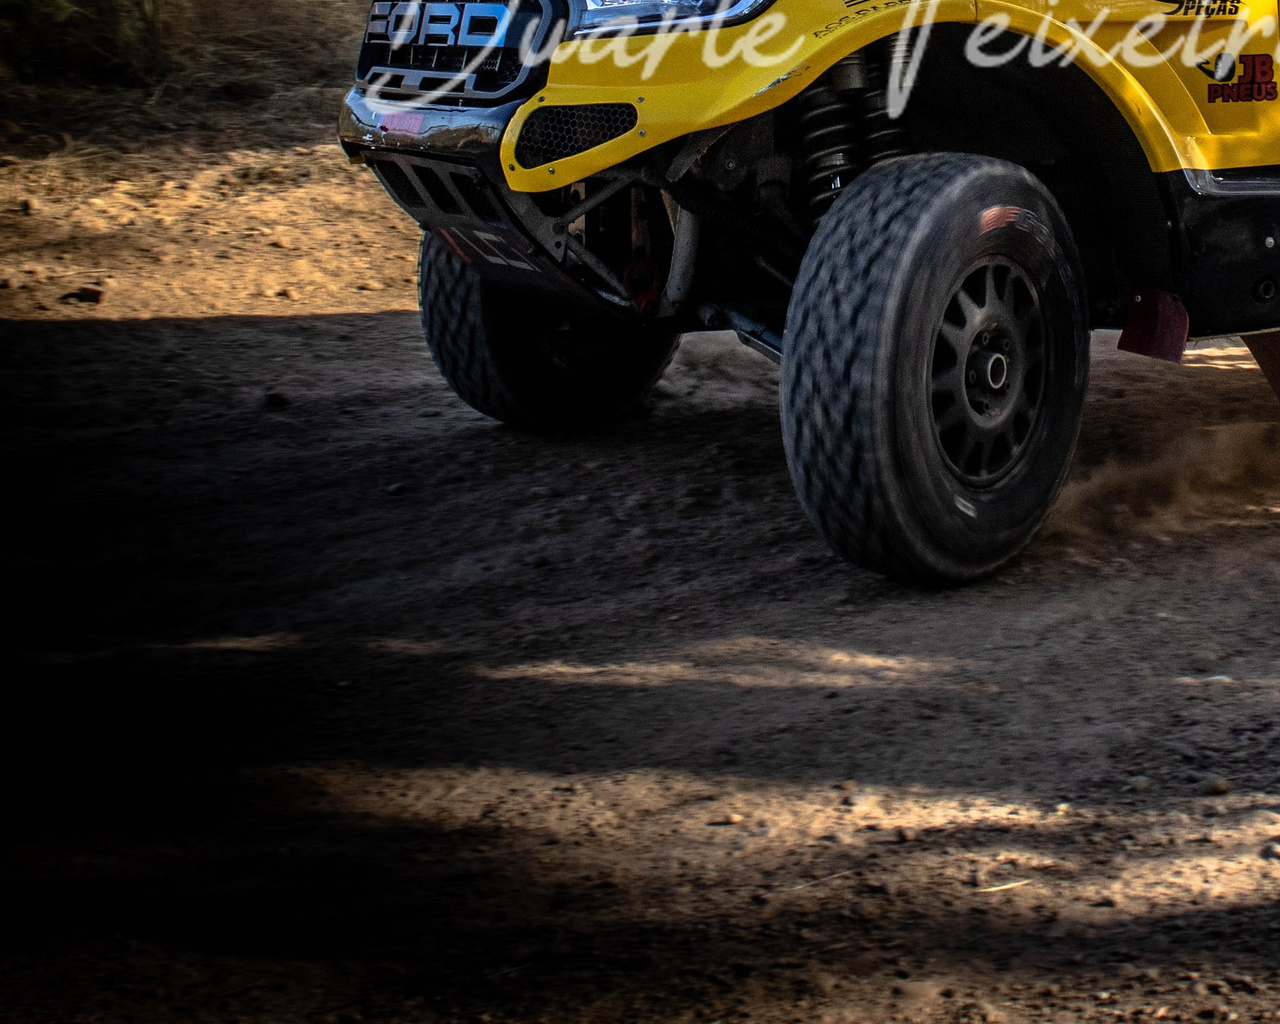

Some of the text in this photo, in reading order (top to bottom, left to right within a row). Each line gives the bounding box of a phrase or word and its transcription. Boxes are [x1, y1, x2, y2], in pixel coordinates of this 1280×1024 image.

[365, 1, 512, 47] FORD
[1237, 53, 1275, 84] JB
[1207, 81, 1279, 104] PNEUS
